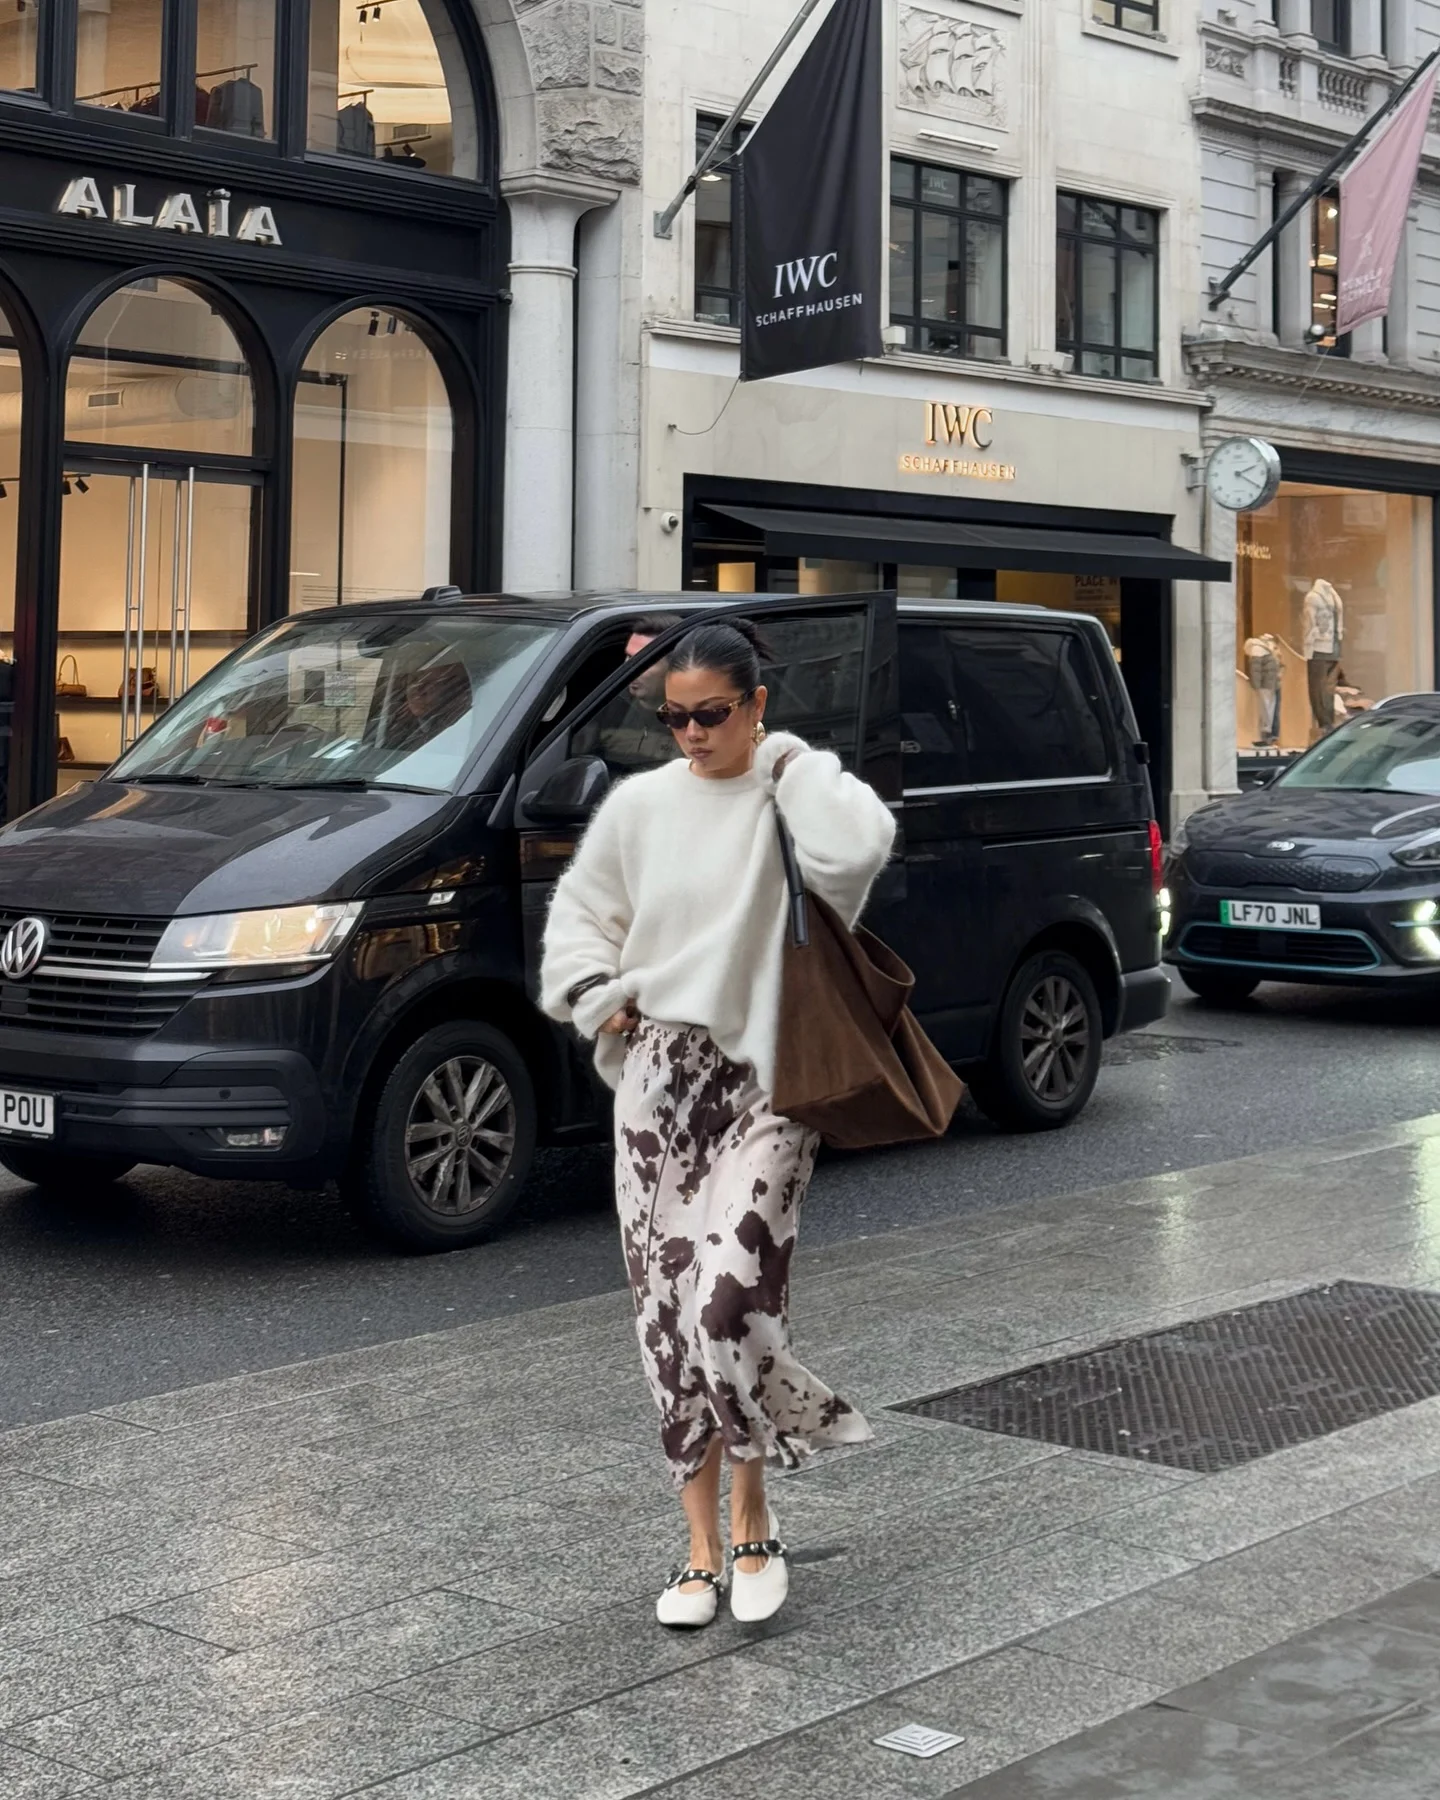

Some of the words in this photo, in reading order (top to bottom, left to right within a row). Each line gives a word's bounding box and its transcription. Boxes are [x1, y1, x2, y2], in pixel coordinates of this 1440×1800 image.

[57, 176, 283, 246] ALAÏA
[772, 251, 838, 299] IWC
[755, 293, 863, 327] SCHAFFHAUSEN
[925, 402, 993, 449] IWC
[900, 455, 1016, 479] SCHAFFHAUSEN
[1231, 903, 1276, 924] LF70
[1281, 906, 1317, 926] JNL
[4, 1093, 46, 1128] POU
